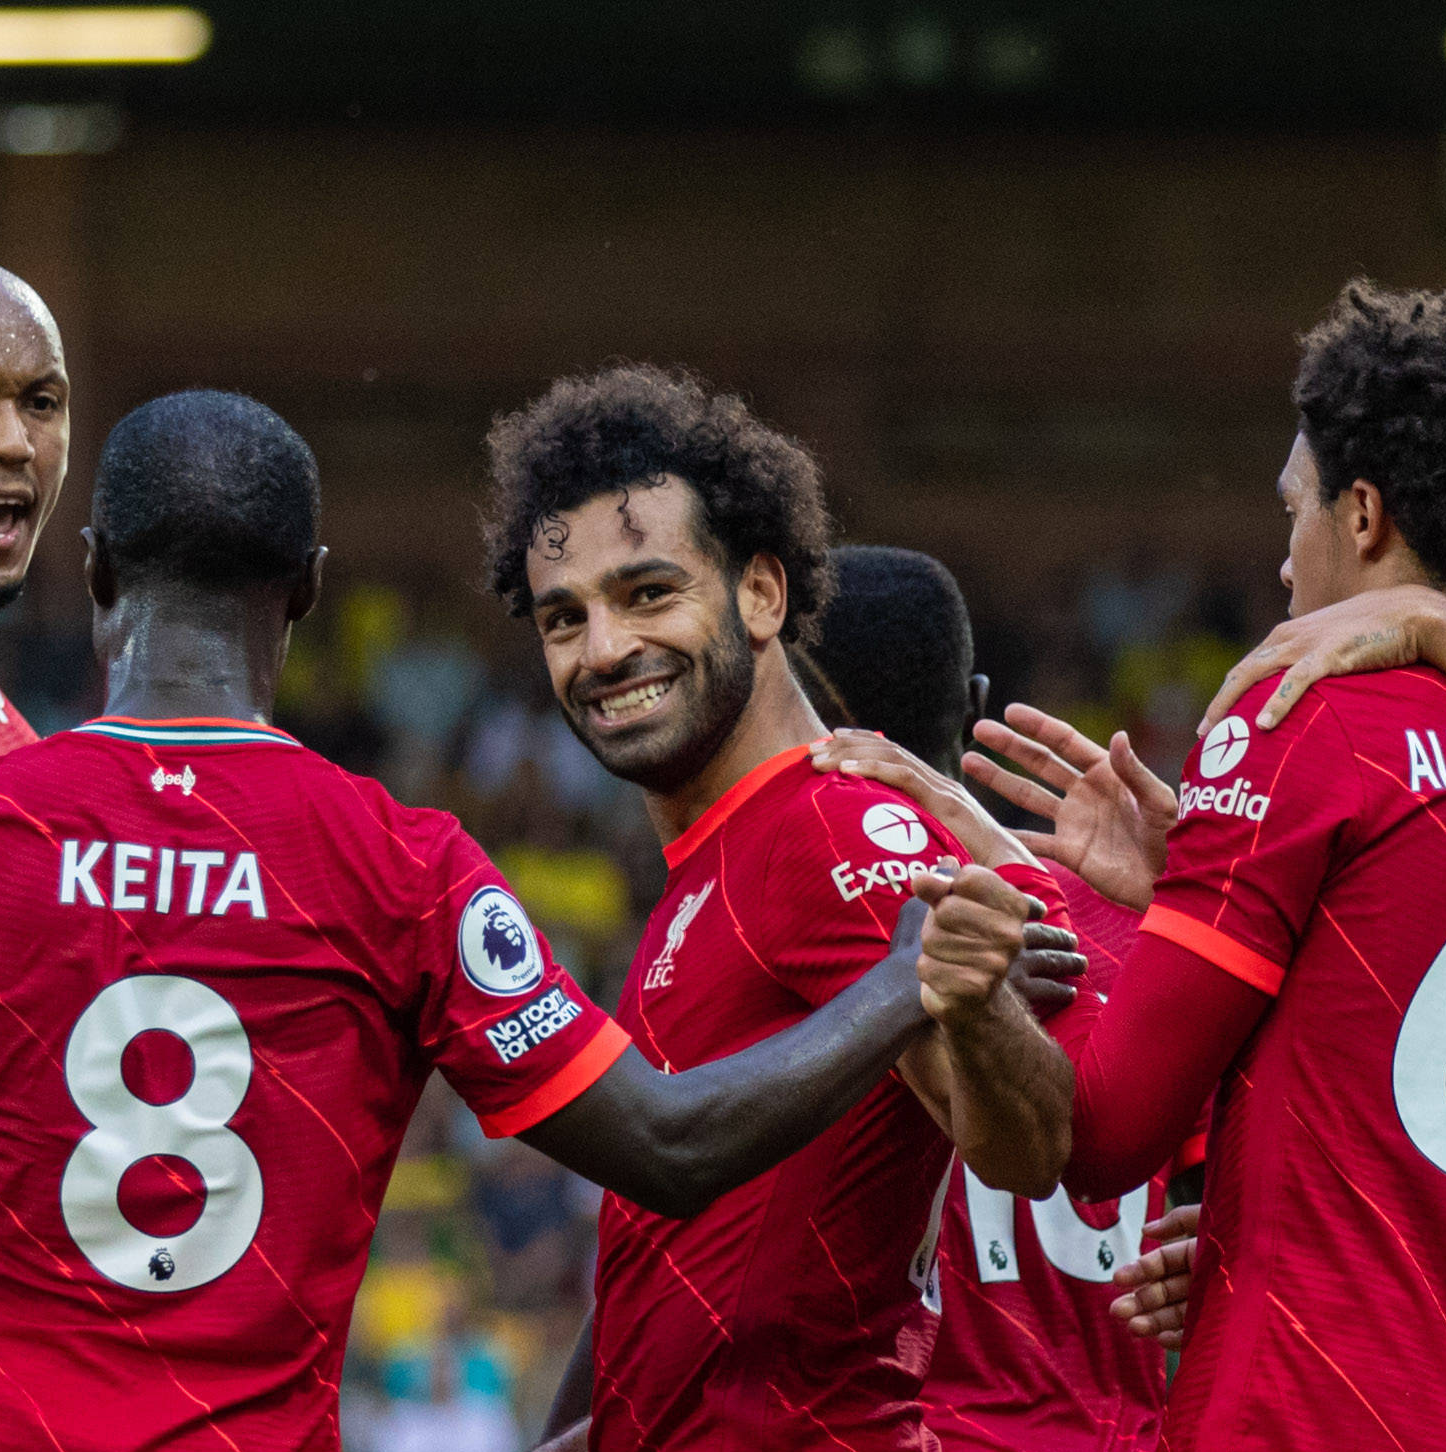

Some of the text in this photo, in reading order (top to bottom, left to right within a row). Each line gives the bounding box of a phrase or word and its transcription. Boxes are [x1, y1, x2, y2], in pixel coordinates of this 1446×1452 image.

[59, 839, 269, 920] KEITA
[643, 964, 676, 991] LFC
[484, 1016, 522, 1050] No
[60, 972, 264, 1293] 8
